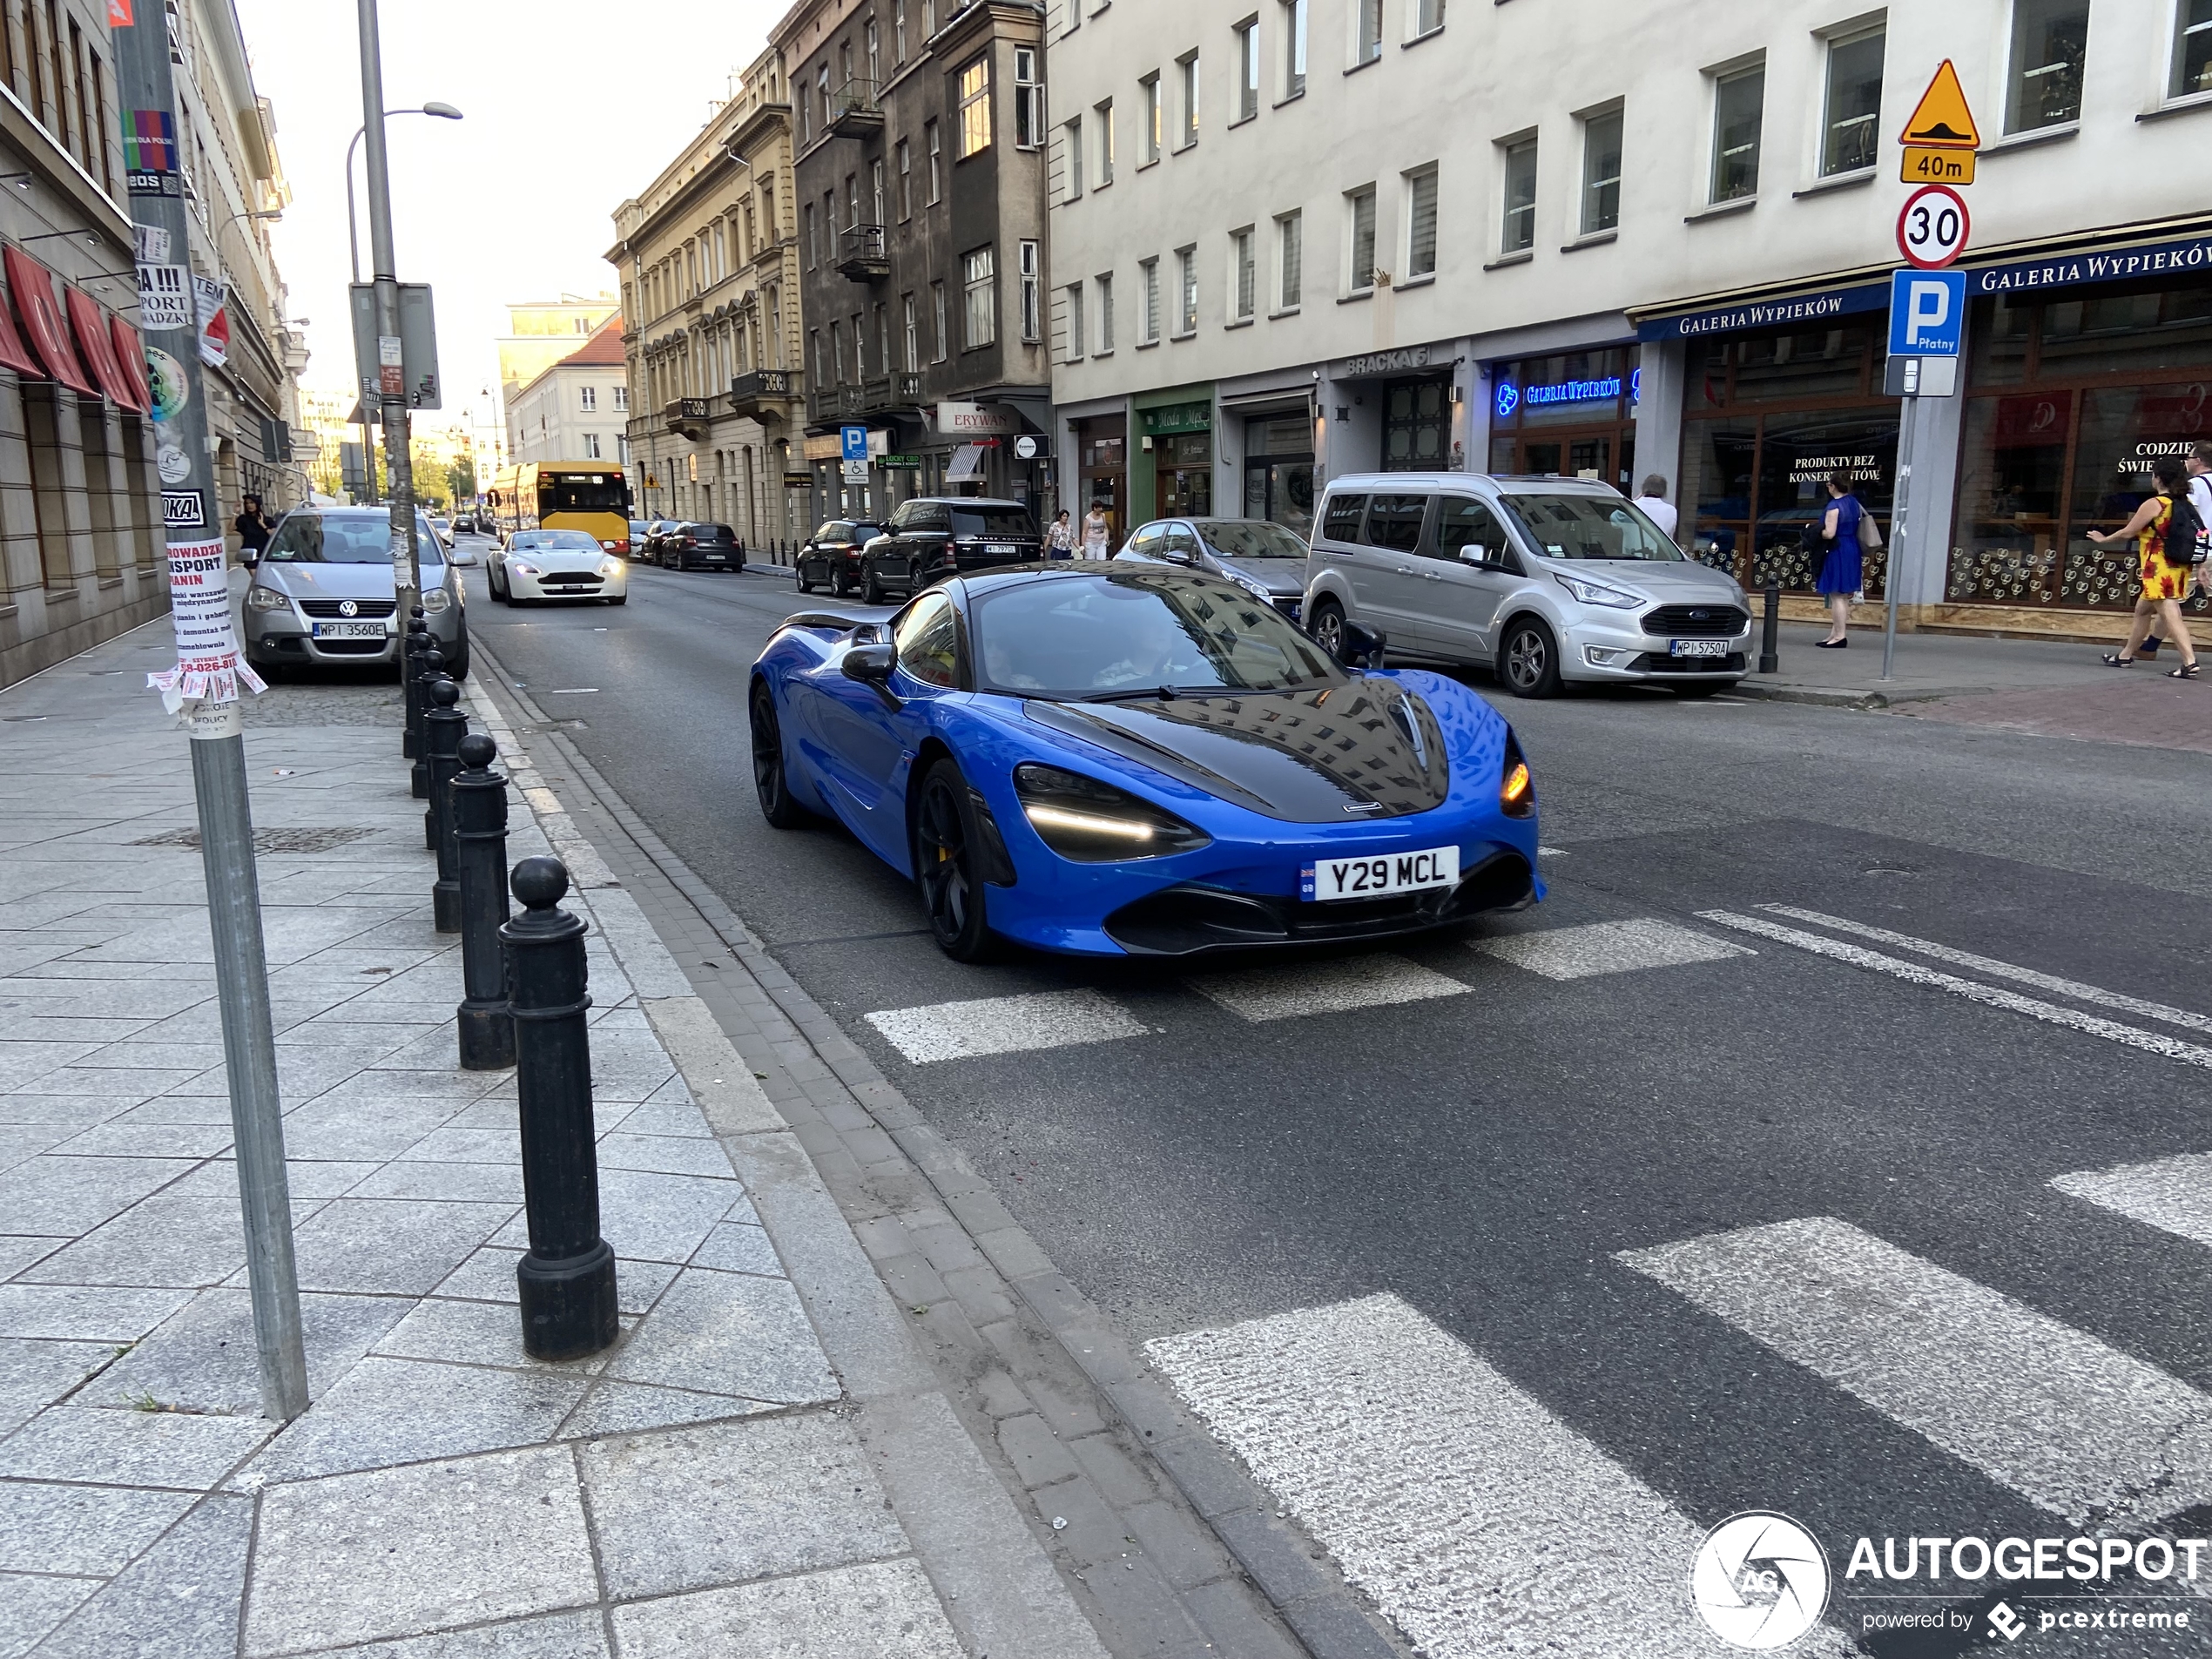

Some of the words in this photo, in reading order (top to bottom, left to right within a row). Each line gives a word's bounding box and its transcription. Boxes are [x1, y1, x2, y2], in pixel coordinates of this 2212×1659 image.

[1918, 156, 1962, 177] 40m
[1908, 206, 1959, 246] 30
[1981, 264, 2081, 291] GALERIA
[1679, 313, 1747, 334] GALERIA
[1750, 296, 1843, 324] WYPIEKÓW
[1906, 280, 1950, 345] P
[1919, 337, 1954, 352] Płatny
[1346, 350, 1411, 375] BRACKA
[1417, 347, 1426, 365] 5
[1527, 385, 1568, 404] GALERIA
[1568, 377, 1621, 399] WYPIEKÓW
[1157, 409, 1180, 428] Moda
[1185, 408, 1211, 428] Męs
[846, 429, 862, 450] P
[2135, 442, 2194, 455] CODZIE
[1795, 456, 1852, 469] PRODUKTY
[1853, 455, 1875, 466] BEZ
[2117, 457, 2156, 474] ŚWIE
[347, 624, 383, 636] 3560E
[1698, 643, 1726, 654] 5750A
[1332, 860, 1387, 893] Y29
[1398, 853, 1446, 887] MCL
